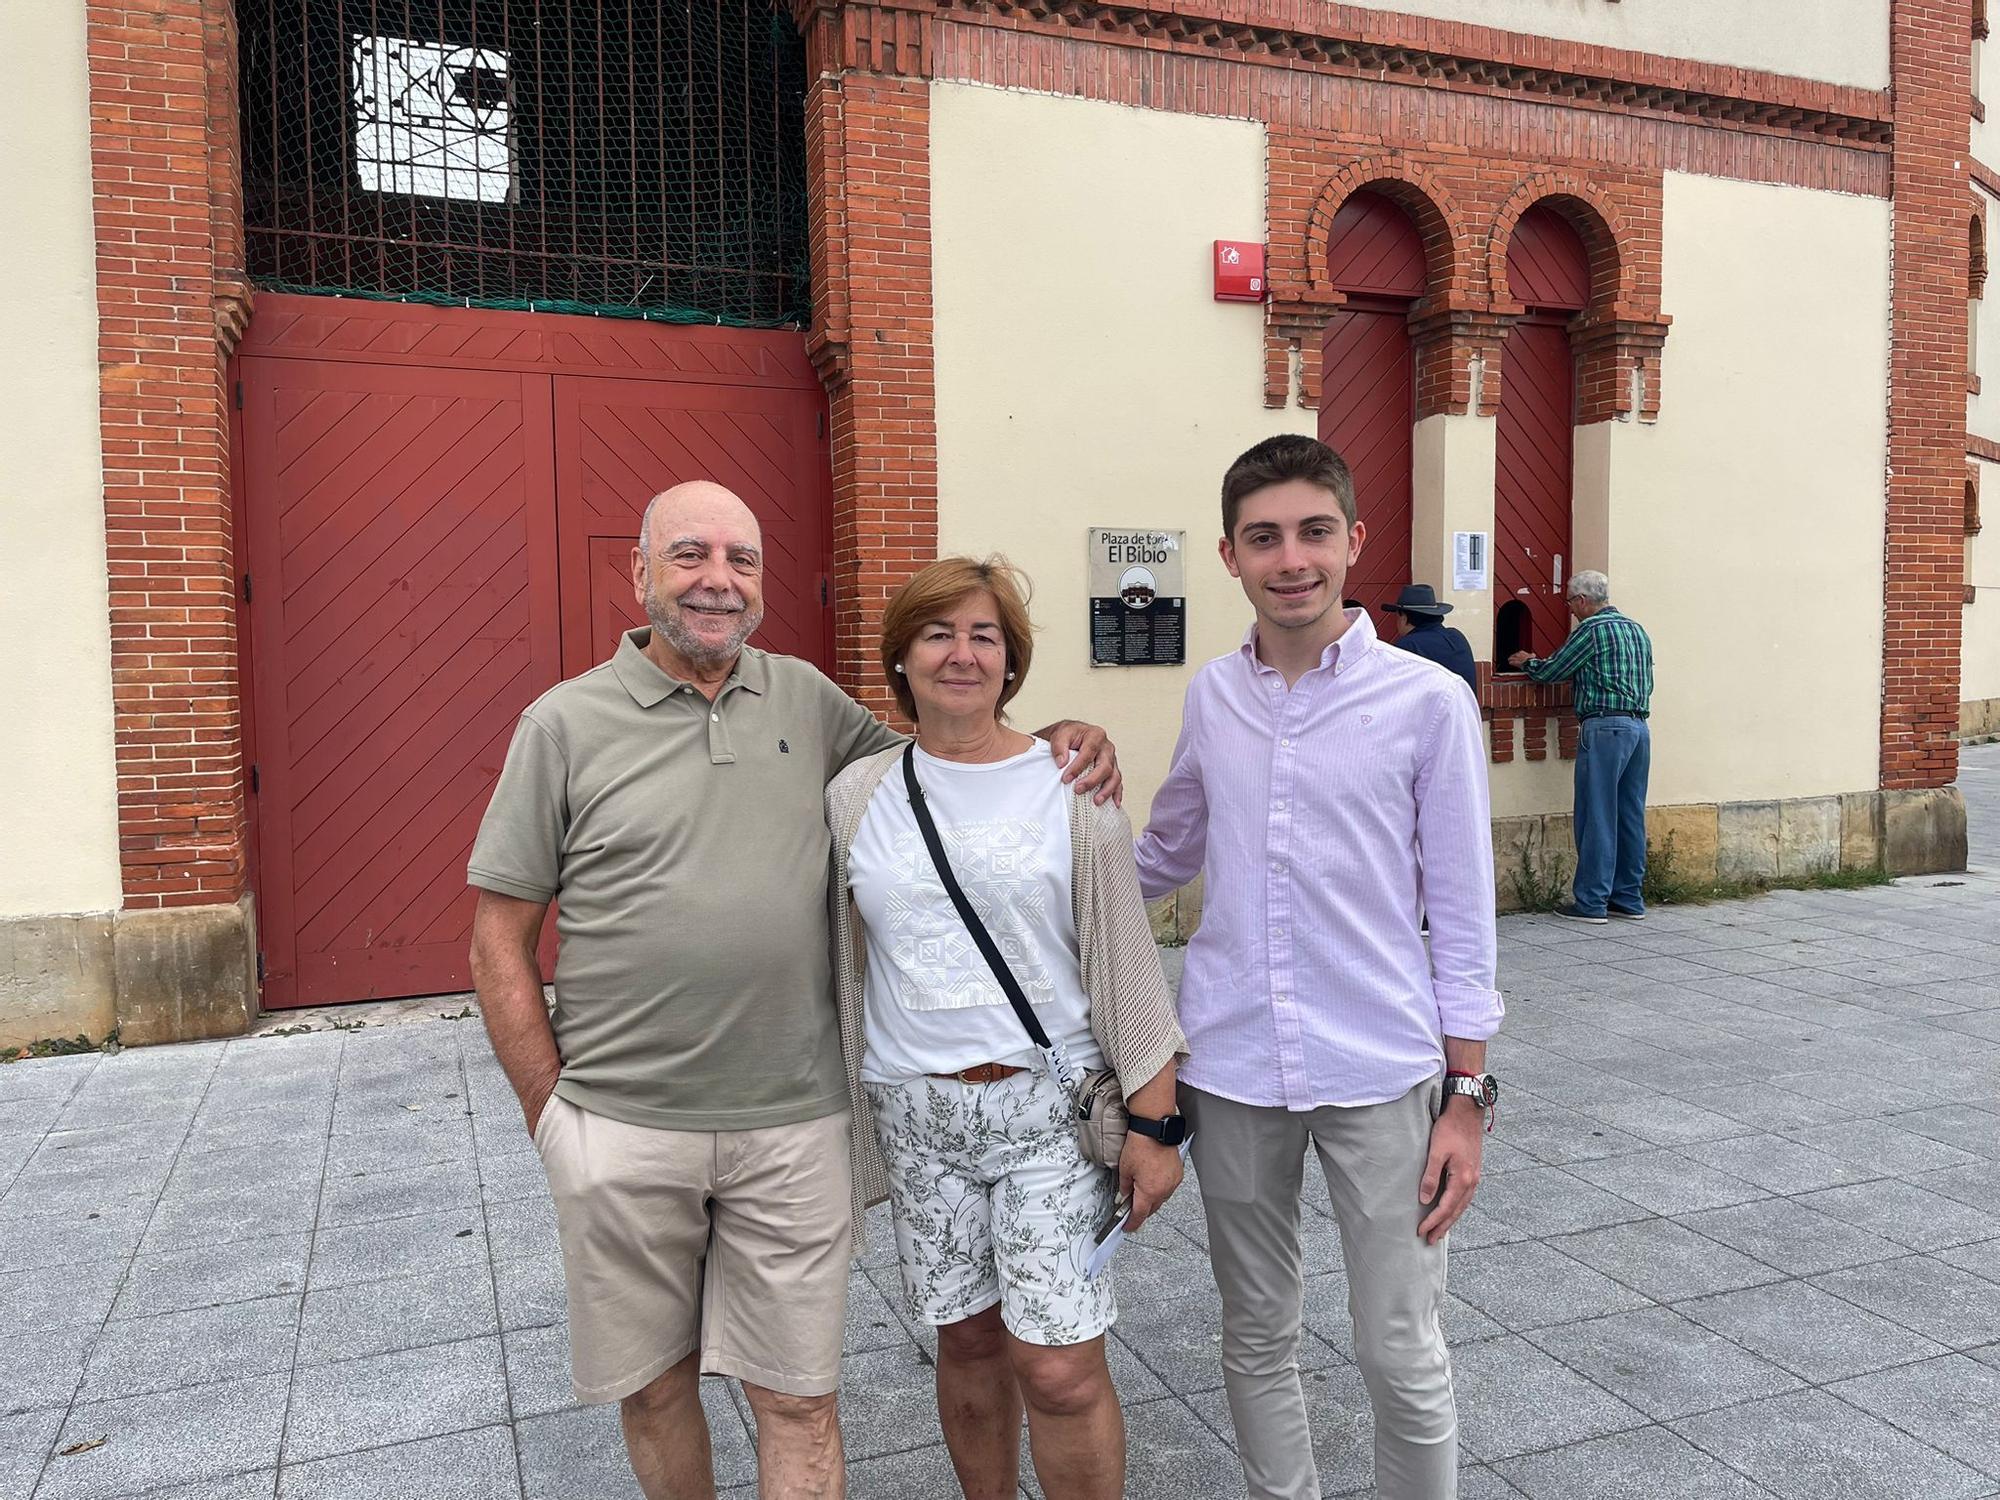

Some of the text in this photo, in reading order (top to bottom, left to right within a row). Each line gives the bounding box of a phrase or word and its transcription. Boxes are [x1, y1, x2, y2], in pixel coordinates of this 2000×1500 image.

[1101, 532, 1171, 545] Plaza de tor
[1109, 545, 1167, 563] El Bibio
